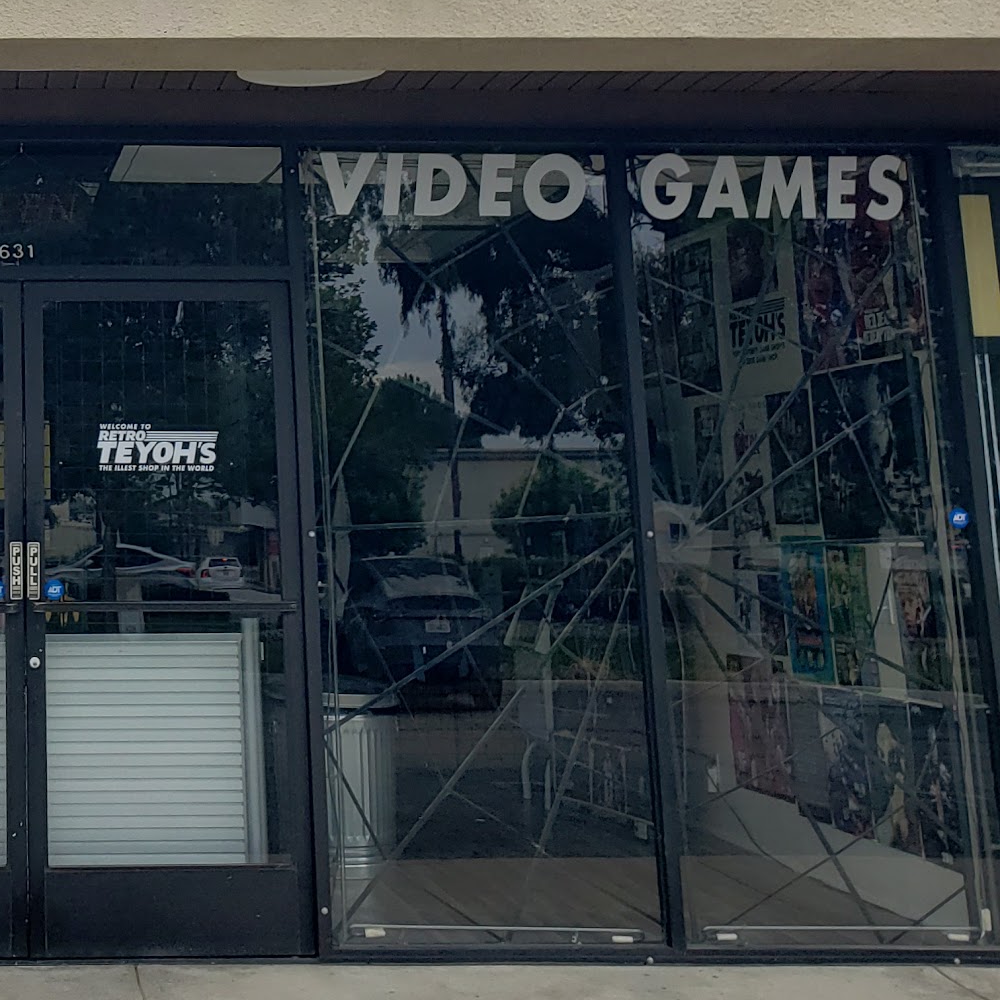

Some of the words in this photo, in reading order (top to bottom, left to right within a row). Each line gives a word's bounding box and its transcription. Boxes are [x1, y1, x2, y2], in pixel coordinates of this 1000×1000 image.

[319, 153, 586, 221] VIDEO
[640, 153, 904, 221] GAMES
[0, 243, 34, 259] 631
[98, 430, 146, 441] RETRO
[97, 441, 216, 464] TEYOH'S
[12, 546, 21, 586] PUSH
[29, 547, 38, 586] PULL
